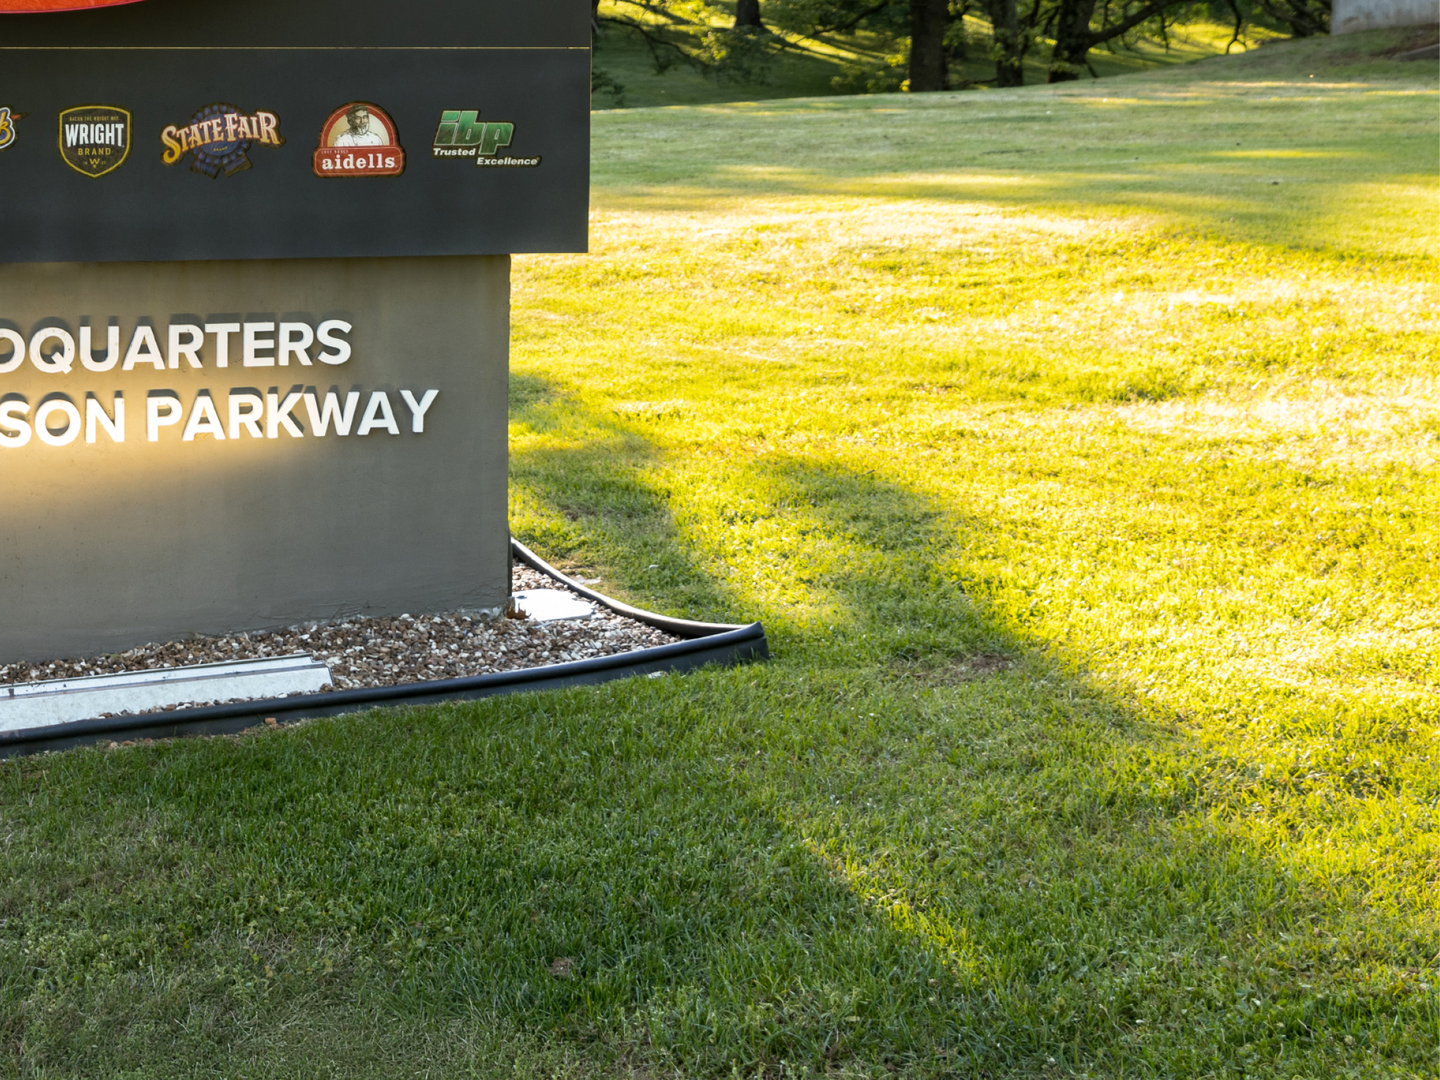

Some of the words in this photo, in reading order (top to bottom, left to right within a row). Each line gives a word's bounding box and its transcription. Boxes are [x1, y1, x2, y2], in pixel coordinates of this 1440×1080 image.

[64, 123, 124, 148] WRIGHT
[161, 118, 225, 164] STATE
[223, 111, 281, 145] FAIR
[433, 110, 514, 155] ibp
[77, 147, 112, 156] BRAND
[321, 153, 396, 170] aidells
[433, 148, 477, 156] Trusted
[476, 157, 538, 165] Excellence
[146, 389, 440, 443] PARKWAY
